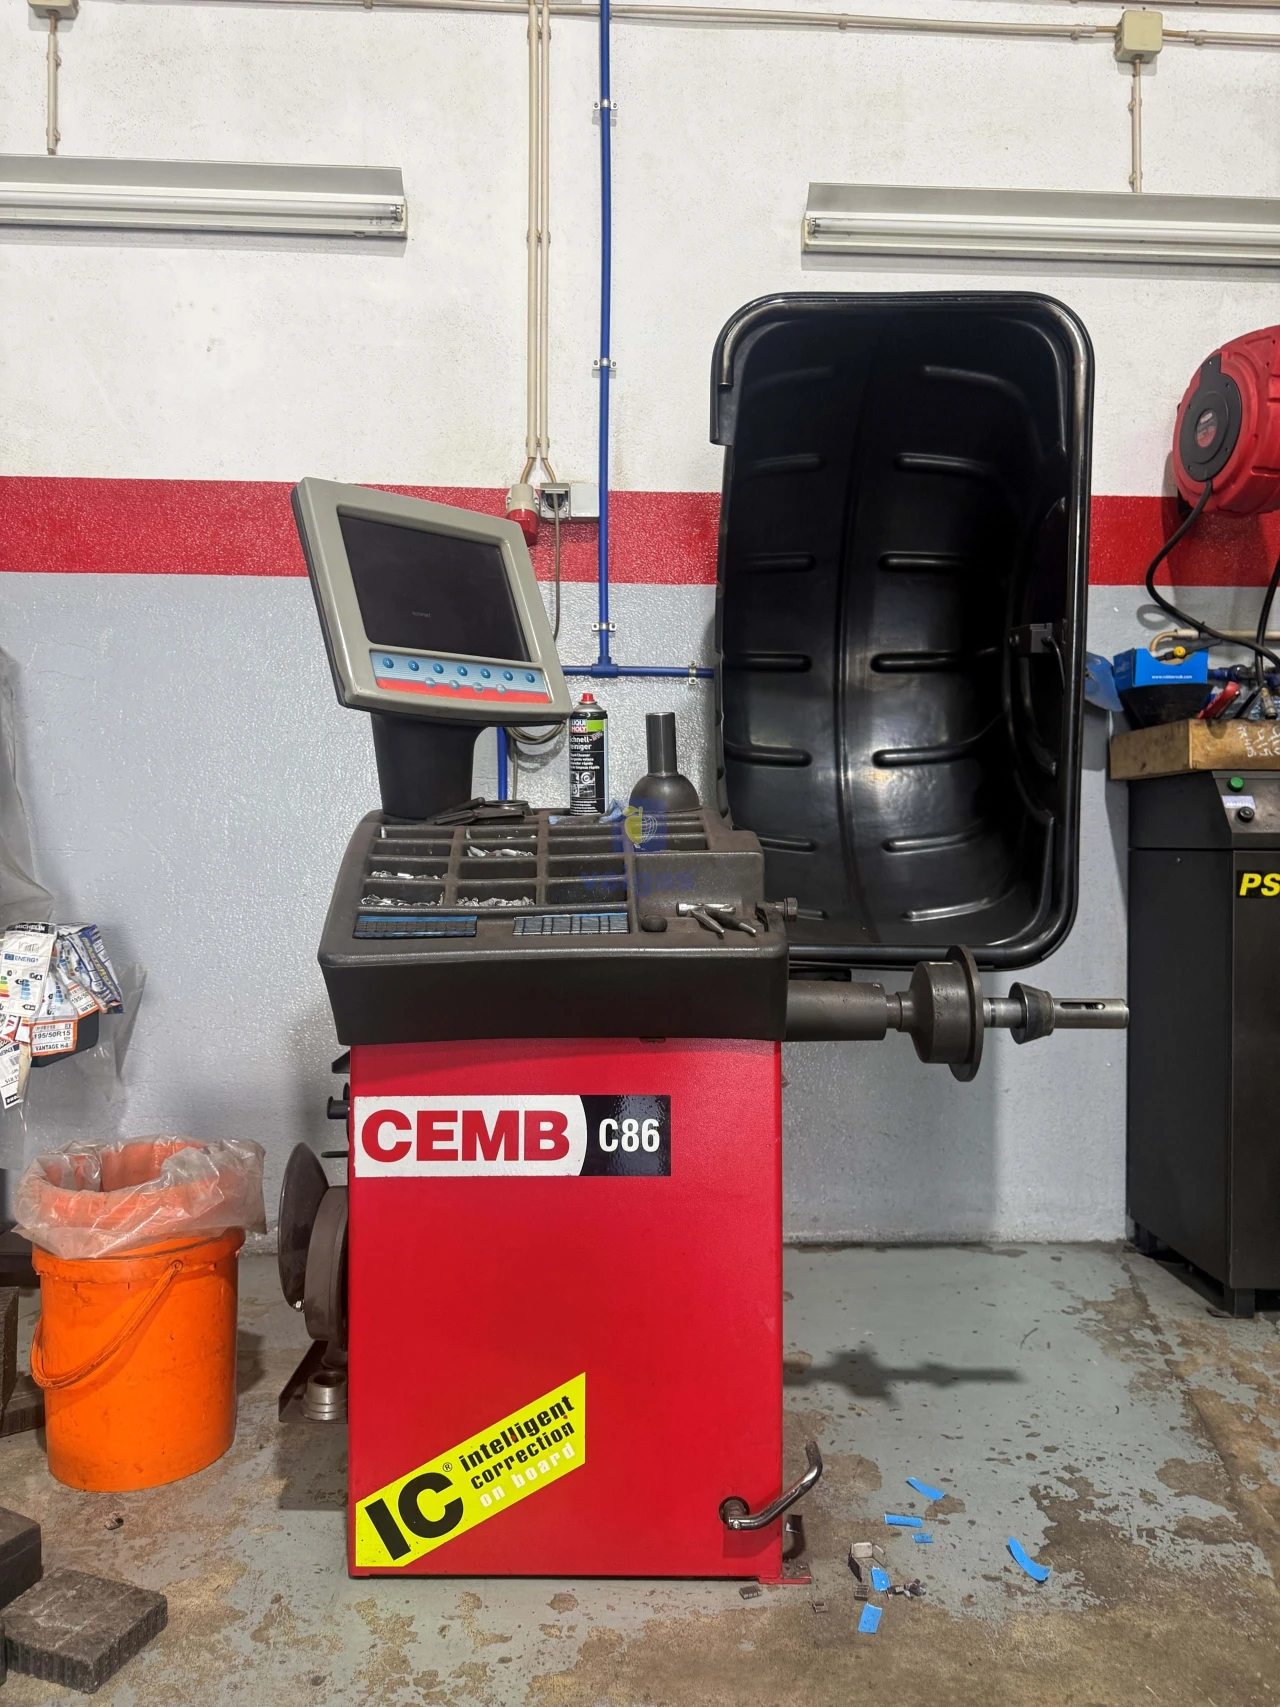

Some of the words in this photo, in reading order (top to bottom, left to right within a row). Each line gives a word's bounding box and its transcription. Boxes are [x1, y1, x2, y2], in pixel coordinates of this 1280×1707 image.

[15, 923, 46, 932] MICHELIN
[361, 1109, 570, 1163] CEMB
[599, 1118, 660, 1152] C86
[458, 1395, 575, 1472] intelligent
[470, 1421, 575, 1490] correction
[479, 1484, 506, 1508] on
[510, 1442, 576, 1489] board
